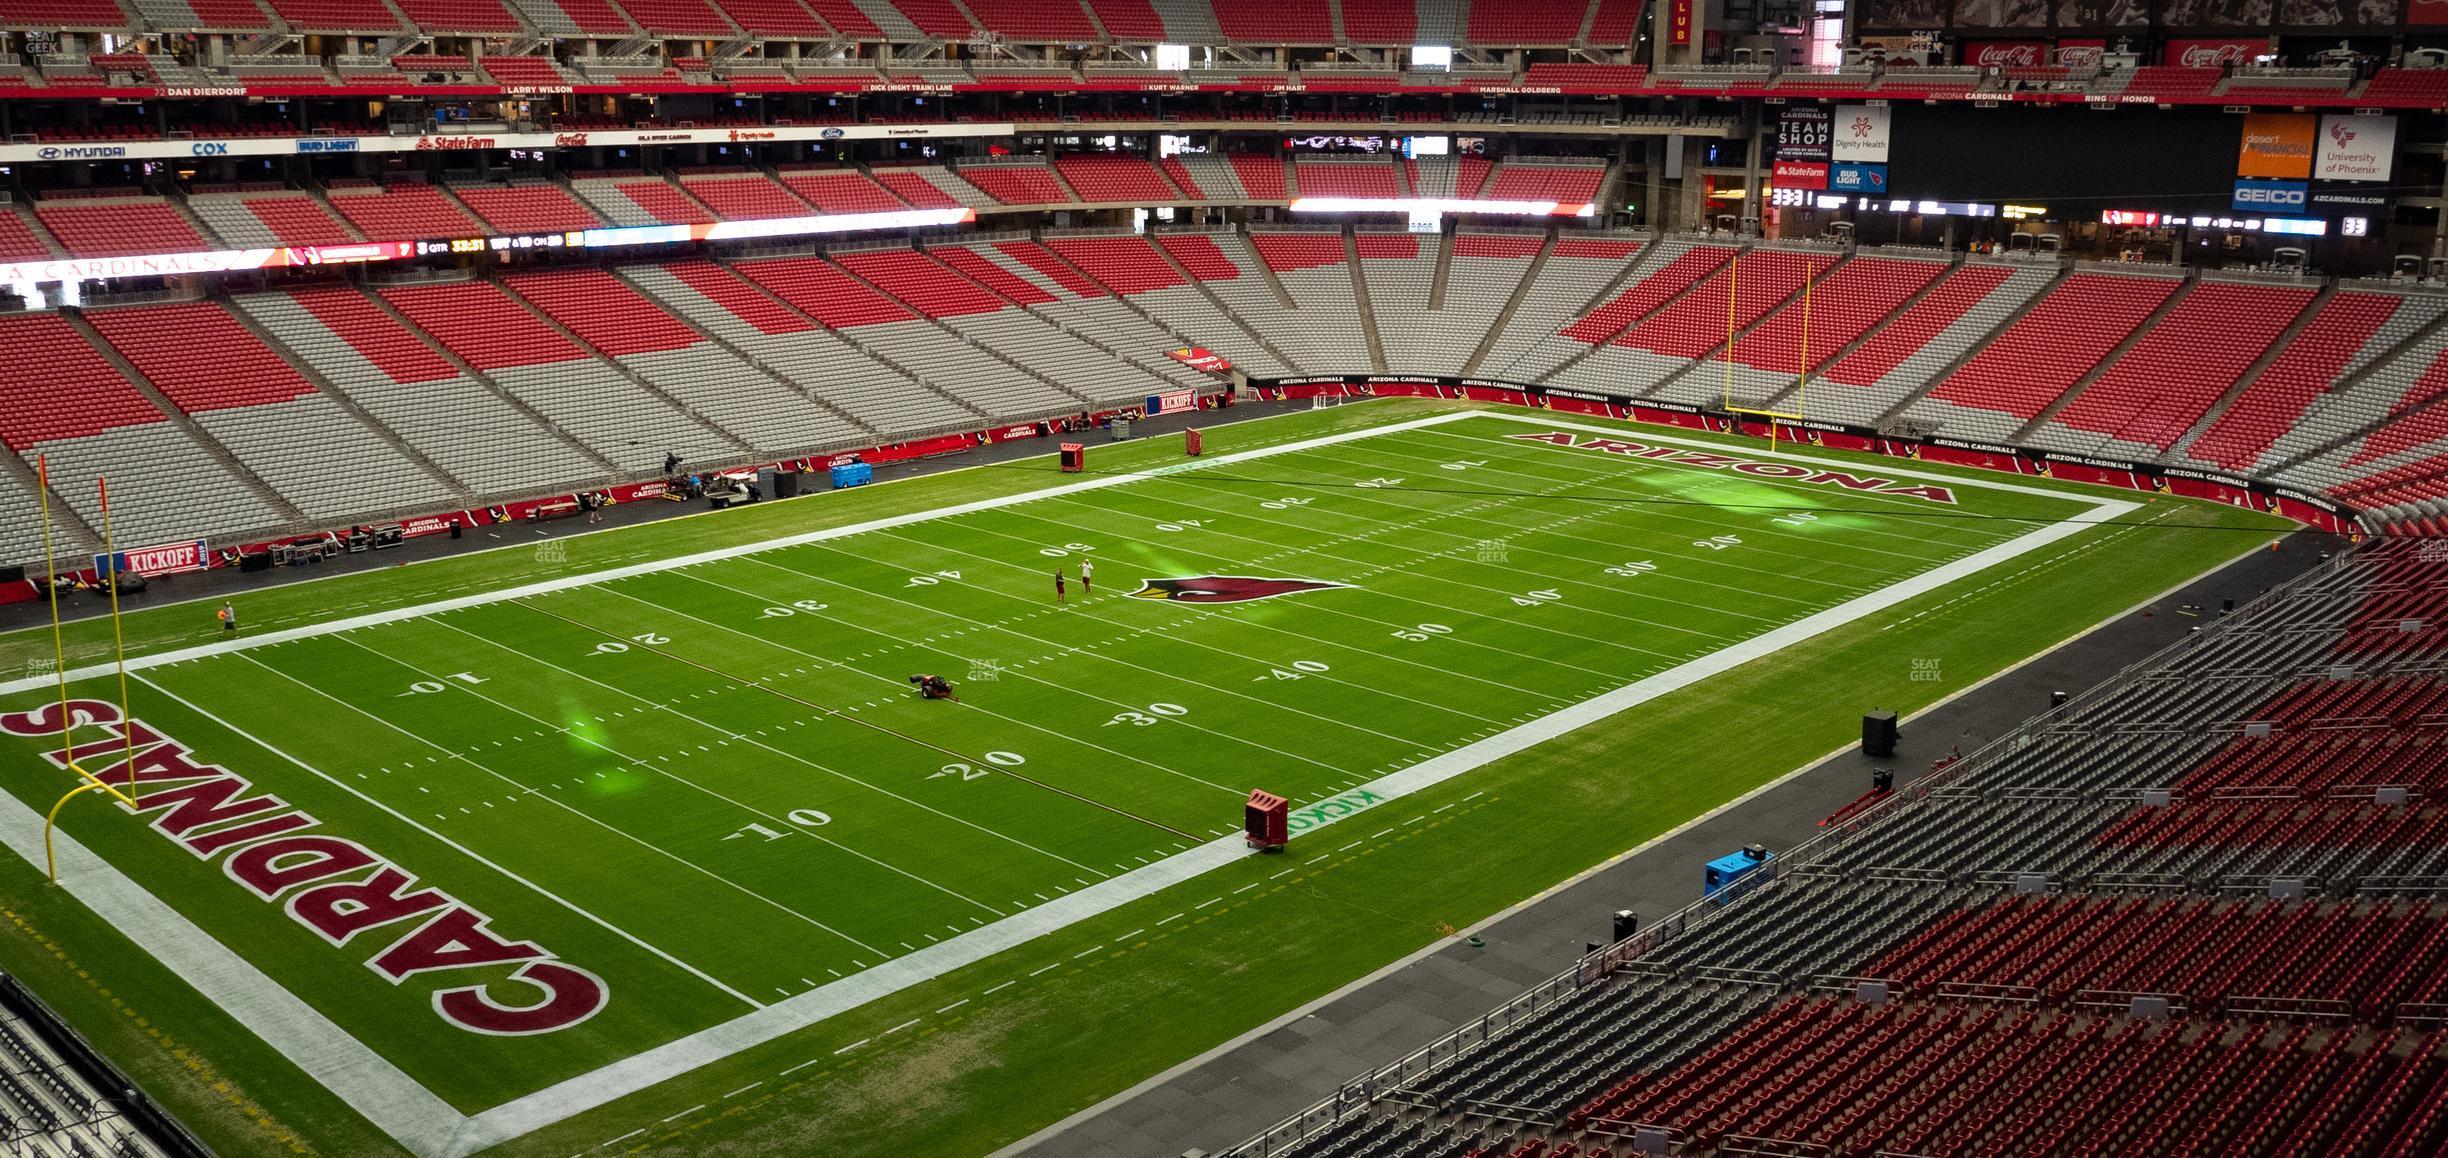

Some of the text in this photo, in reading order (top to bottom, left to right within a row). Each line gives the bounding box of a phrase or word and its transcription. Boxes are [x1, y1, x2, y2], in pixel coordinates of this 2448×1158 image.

[168, 88, 191, 96] DAN
[193, 87, 247, 96] DIERDORF
[507, 86, 536, 94] LARRY
[887, 84, 911, 92] (NIGHT
[911, 84, 935, 92] TRAIN)
[1965, 93, 2014, 101] CARDINALS
[2084, 94, 2107, 102] RING
[2122, 95, 2156, 103] HONOR
[825, 128, 841, 138] Ford
[1779, 122, 1828, 134] TEAM
[1779, 133, 1828, 145] SHOP
[1835, 139, 1886, 149] Dignity Health
[2246, 133, 2281, 143] desert
[64, 147, 126, 158] HYUNDAI
[192, 143, 228, 156] COX
[299, 140, 358, 152] BUD LIGHT
[2327, 153, 2377, 165] University
[2325, 164, 2378, 175] of Phoenix
[1836, 176, 1861, 185] LIGHT
[1772, 188, 1813, 206] 33:31
[2235, 188, 2305, 204] GEICO
[2313, 195, 2385, 204] AZCARDINALS.COM
[44, 256, 217, 279] CARDINALS
[1279, 376, 1344, 386] ARIZONA CARDINALS
[1462, 380, 1526, 392] ARIZONA CARDINALS
[1161, 393, 1192, 410] KICKOFF
[1546, 388, 1609, 403] ARIZONA CARDINALS
[1630, 399, 1697, 413] ARIZONA CARDINALS
[1003, 428, 1036, 439] CARDINALS
[1804, 421, 1845, 432] CARDINALS
[1934, 438, 2017, 455] ARIZONA CARDINALS
[828, 459, 853, 468] CARDIN
[1501, 429, 1959, 506] ARIZONA
[2045, 453, 2133, 471] ARIZONA CARDINALS
[2164, 467, 2249, 488] ARIZONA CARDINALS
[631, 487, 669, 499] CARDINA
[640, 482, 668, 491] ARIZONA
[2275, 488, 2337, 512] ARIZONA CARDINALS
[401, 520, 451, 536] CARDINALS
[408, 517, 440, 528] ARIZONA
[1155, 518, 1202, 532] 40
[1039, 542, 1096, 557] 50
[1692, 535, 1743, 551] 20
[129, 545, 207, 573] KICKOFF 2019
[1603, 561, 1658, 578] 30
[909, 569, 962, 586] 40
[1511, 588, 1562, 607] 40
[763, 599, 829, 618] 30
[1391, 623, 1454, 643] 50
[596, 632, 671, 654] 20
[1270, 660, 1330, 681] 40
[410, 671, 491, 694] 10
[1113, 702, 1189, 727] 30
[939, 750, 1026, 782] 20
[739, 808, 832, 842] 10
[0, 698, 610, 1036] CARDINALS
